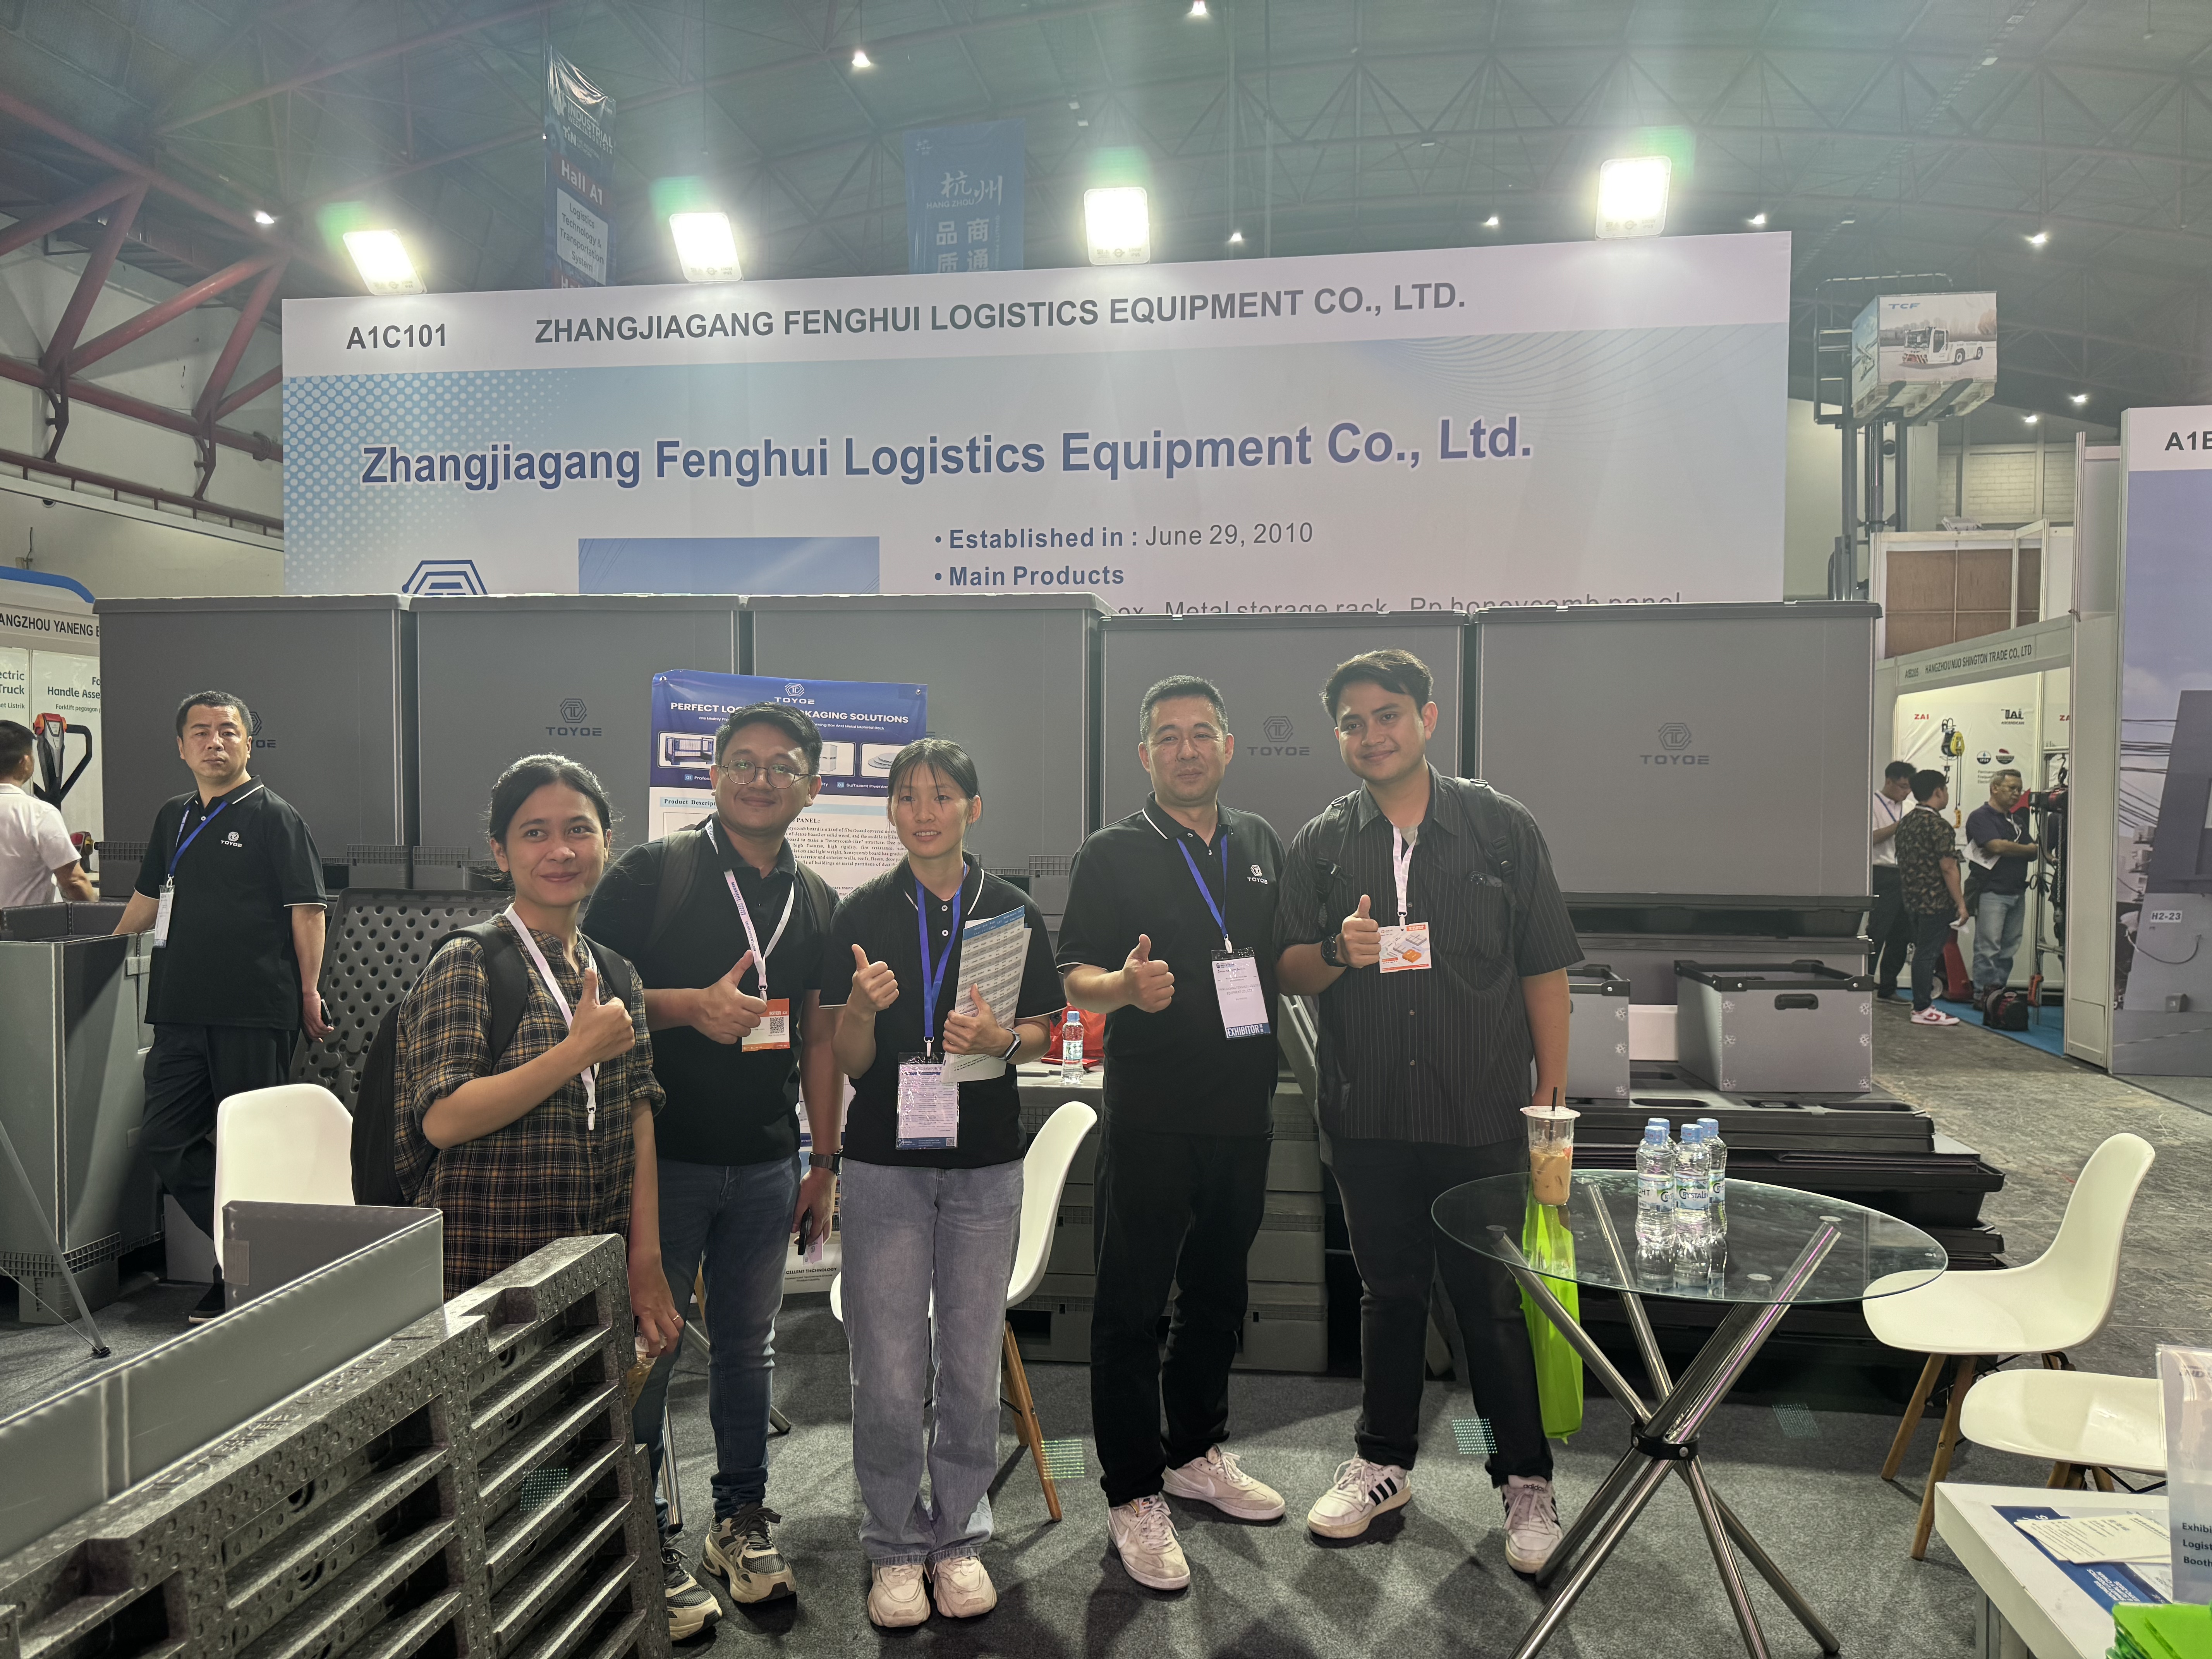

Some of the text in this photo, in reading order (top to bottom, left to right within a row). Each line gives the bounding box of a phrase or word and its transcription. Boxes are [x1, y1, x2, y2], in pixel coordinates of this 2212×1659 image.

[568, 102, 613, 149] INDUSTRIAL
[562, 160, 603, 205] Hall A1
[941, 170, 1003, 206] 杭州
[570, 203, 595, 229] Logistics
[926, 198, 975, 209] HANG ZHOU
[562, 213, 602, 248] Technology &
[560, 228, 604, 265] Transportation
[572, 251, 593, 273] System
[347, 282, 1465, 349] A1C101 ZHANGJIAGANG FENGHUI LOGISTICS EQUIPMENT CO., LTD.
[362, 416, 1532, 490] Zhangjiagang Fenghui Logistics Equipment Co., Ltd.
[949, 526, 1094, 550] Established
[1102, 526, 1123, 547] in
[1146, 524, 1201, 547] June
[1209, 524, 1246, 549] 29,
[1253, 522, 1313, 545] 2010
[949, 562, 1124, 587] Main Products
[54, 620, 93, 636] YANENG
[1925, 662, 1951, 674] HANGZHOU
[1963, 654, 1988, 667] SHINGTON
[1989, 649, 2008, 662] TRADE
[2021, 644, 2032, 657] LTD
[48, 686, 80, 697] Handle
[671, 702, 719, 713] PERFECT
[850, 713, 909, 723] SOLUTIONS
[546, 726, 602, 737] TOYOE
[1247, 746, 1310, 756] TOYOE
[1640, 754, 1710, 765] TOYOE
[220, 840, 242, 848] TOYOE
[1227, 1024, 1260, 1037] EXHIBITOR
